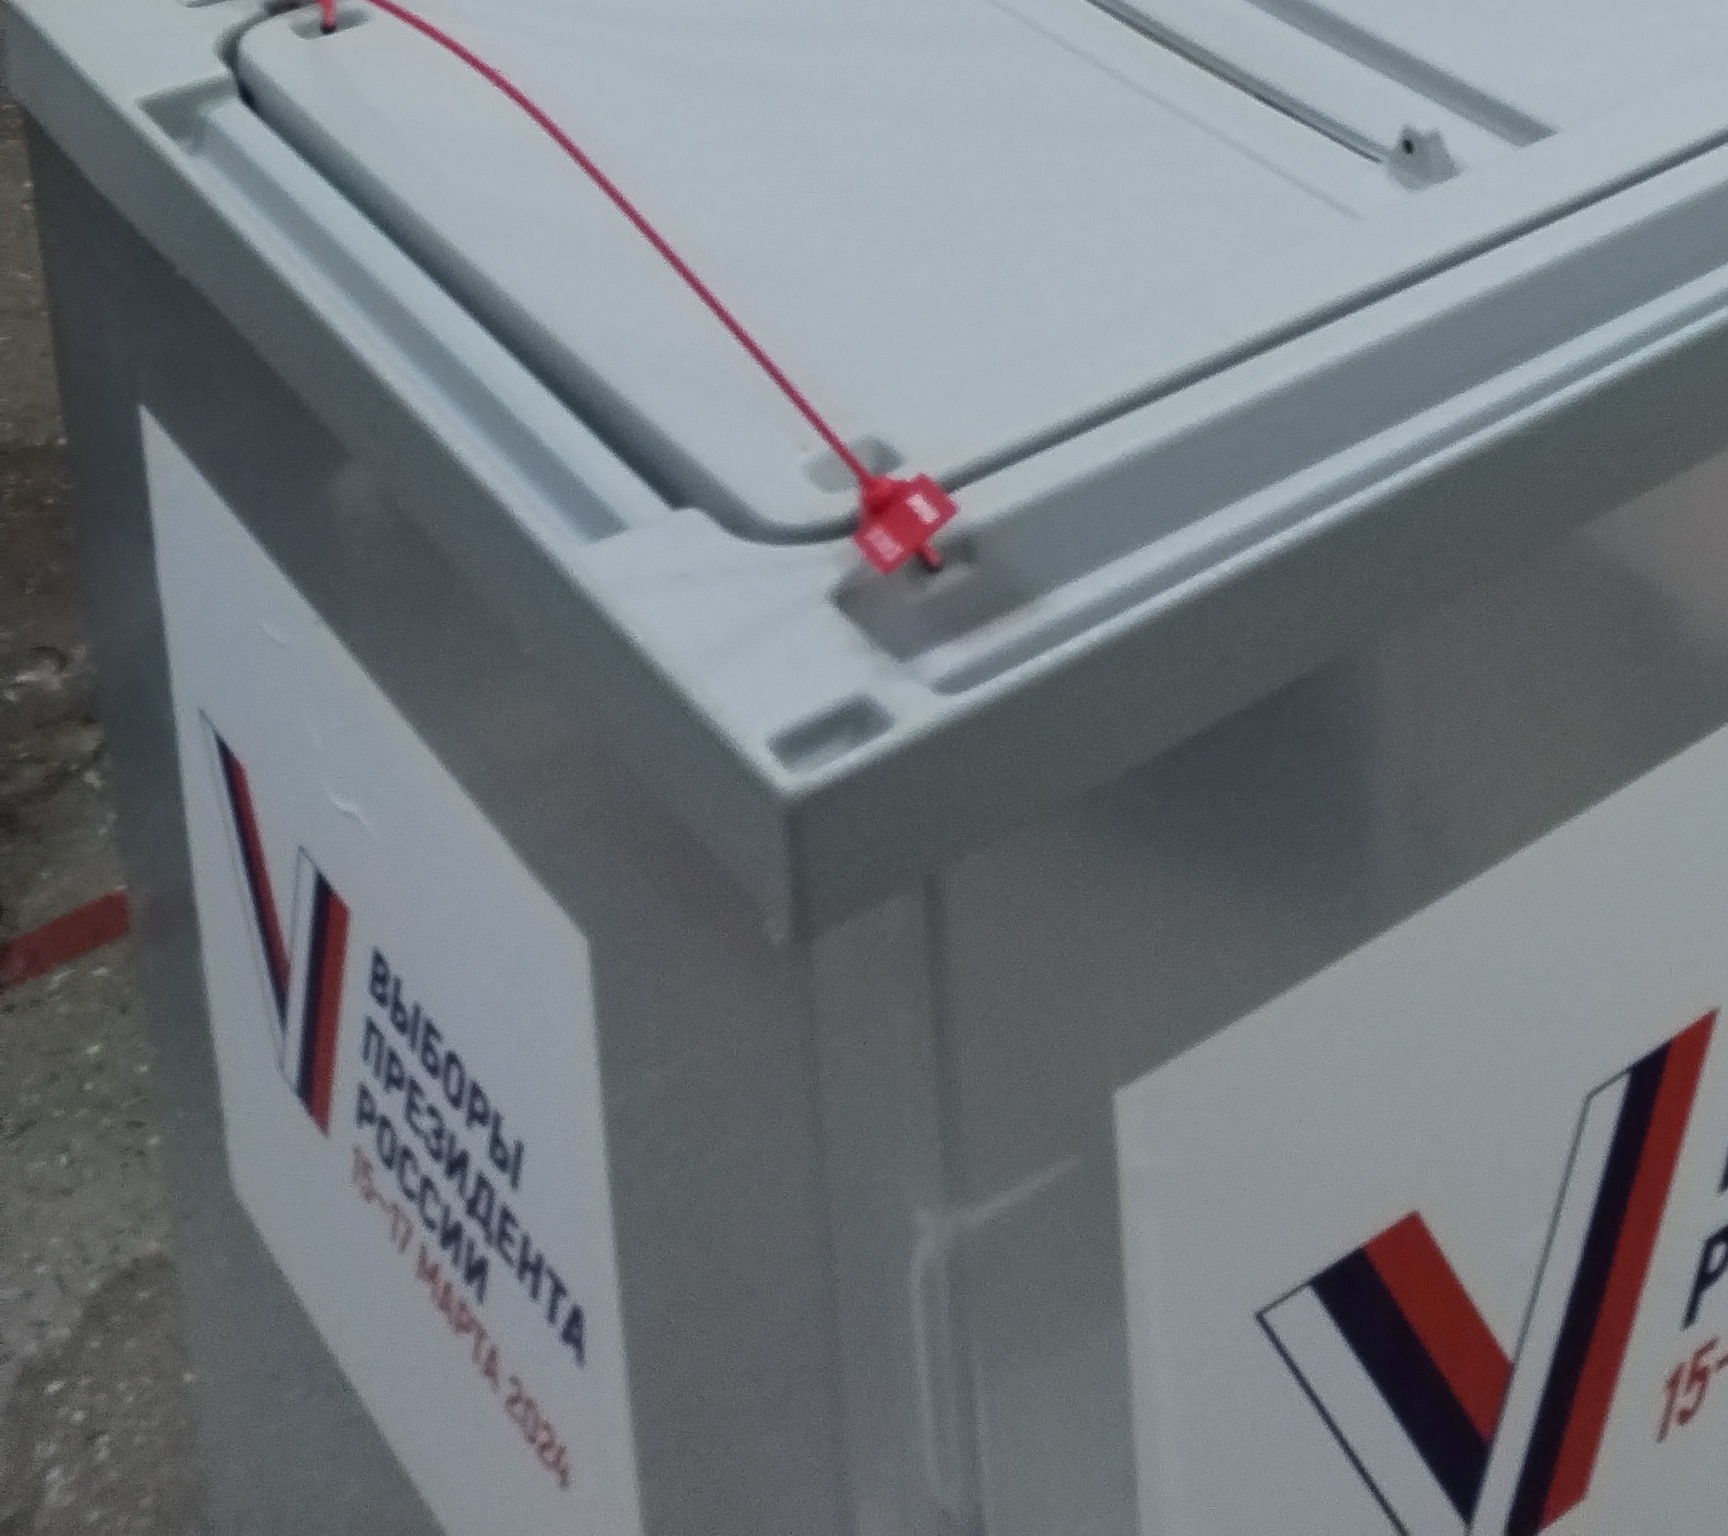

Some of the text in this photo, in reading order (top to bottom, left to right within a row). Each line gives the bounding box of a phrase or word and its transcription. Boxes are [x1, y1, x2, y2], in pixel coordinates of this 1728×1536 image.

[359, 1014, 589, 1369] ПРЕЗИДЕНТА
[368, 943, 526, 1194] ВЫБОРЫ
[354, 1082, 492, 1309] РОССИИ
[415, 1241, 502, 1394] МАРТА
[503, 1372, 575, 1493] 2024
